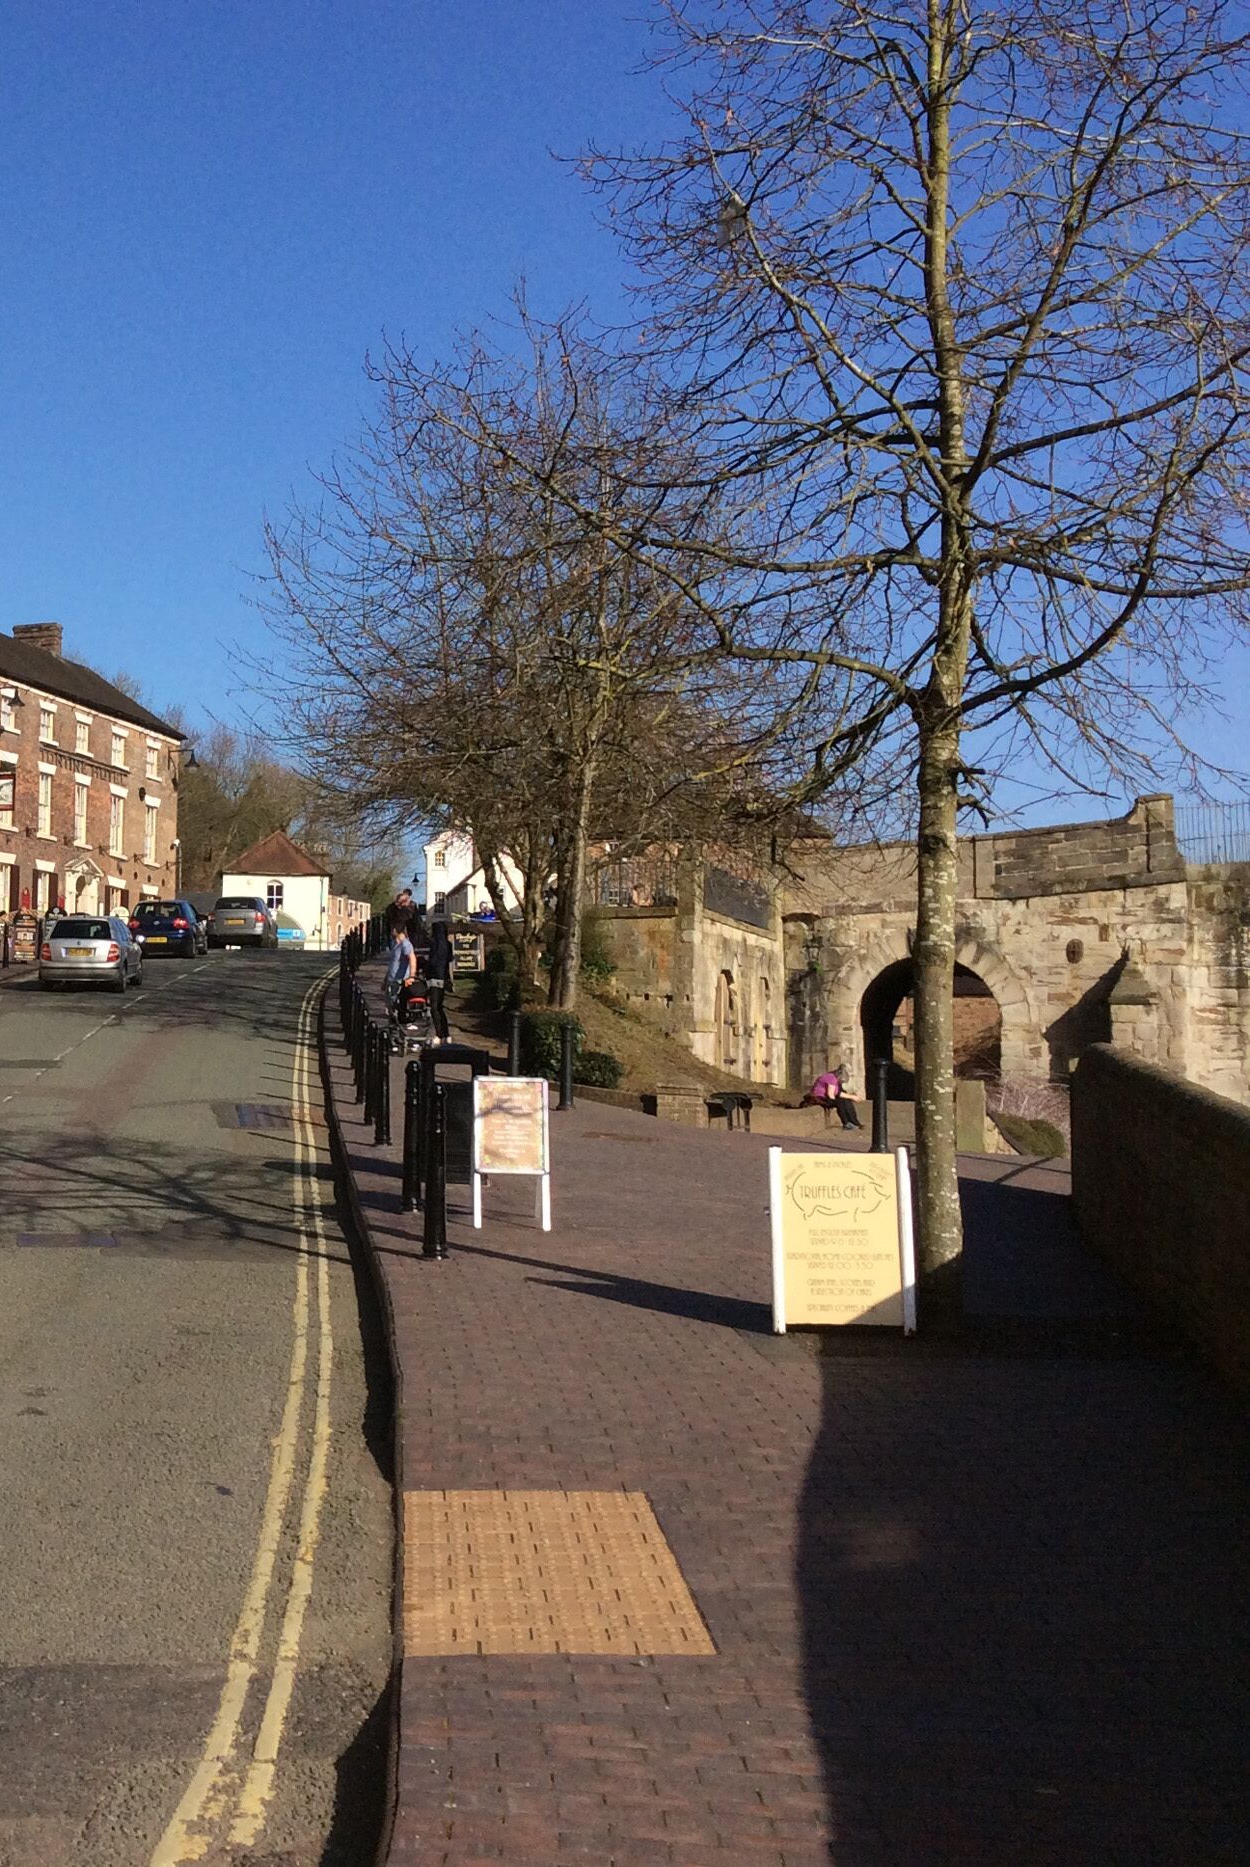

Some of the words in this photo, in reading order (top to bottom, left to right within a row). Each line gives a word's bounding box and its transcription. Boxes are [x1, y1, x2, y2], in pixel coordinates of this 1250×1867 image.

[39, 747, 88, 775] TONTINE
[91, 764, 127, 787] HOTEL
[799, 1185, 841, 1200] TRUFFLES
